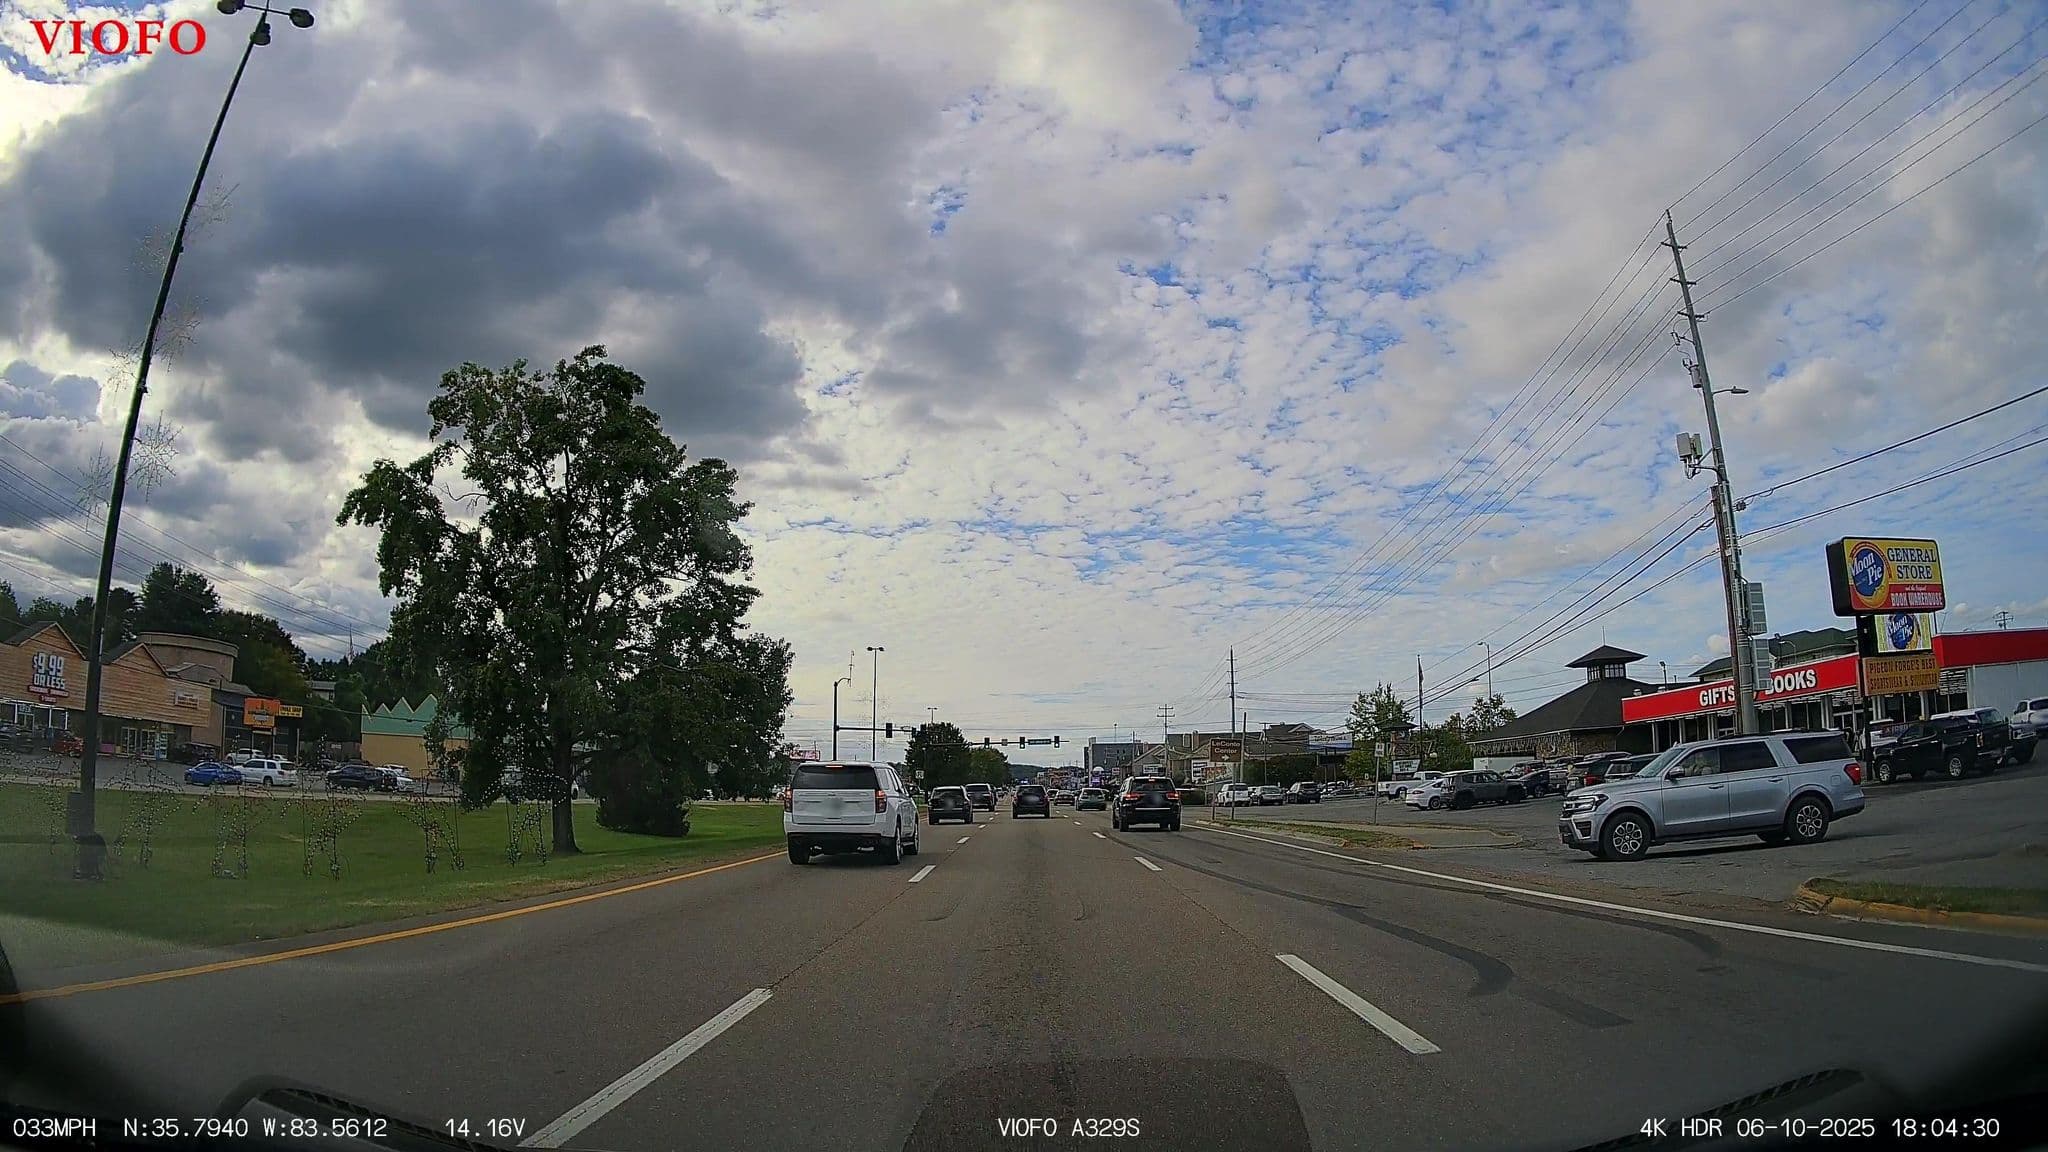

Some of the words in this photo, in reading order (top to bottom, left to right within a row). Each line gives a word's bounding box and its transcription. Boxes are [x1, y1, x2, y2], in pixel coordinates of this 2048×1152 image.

[1887, 548, 1937, 563] GENERAL
[1851, 552, 1876, 577] Moon
[1896, 565, 1933, 580] STORE
[1867, 564, 1883, 586] Pie
[1891, 592, 1908, 606] BOOK
[1908, 592, 1943, 606] WAREHOUSE
[1869, 662, 1893, 674] PIGEON
[1895, 659, 1920, 672] FORGE'S
[1921, 658, 1936, 670] BEST
[33, 673, 47, 687] OR
[46, 675, 66, 690] LESS
[1699, 685, 1735, 707] GIFTS
